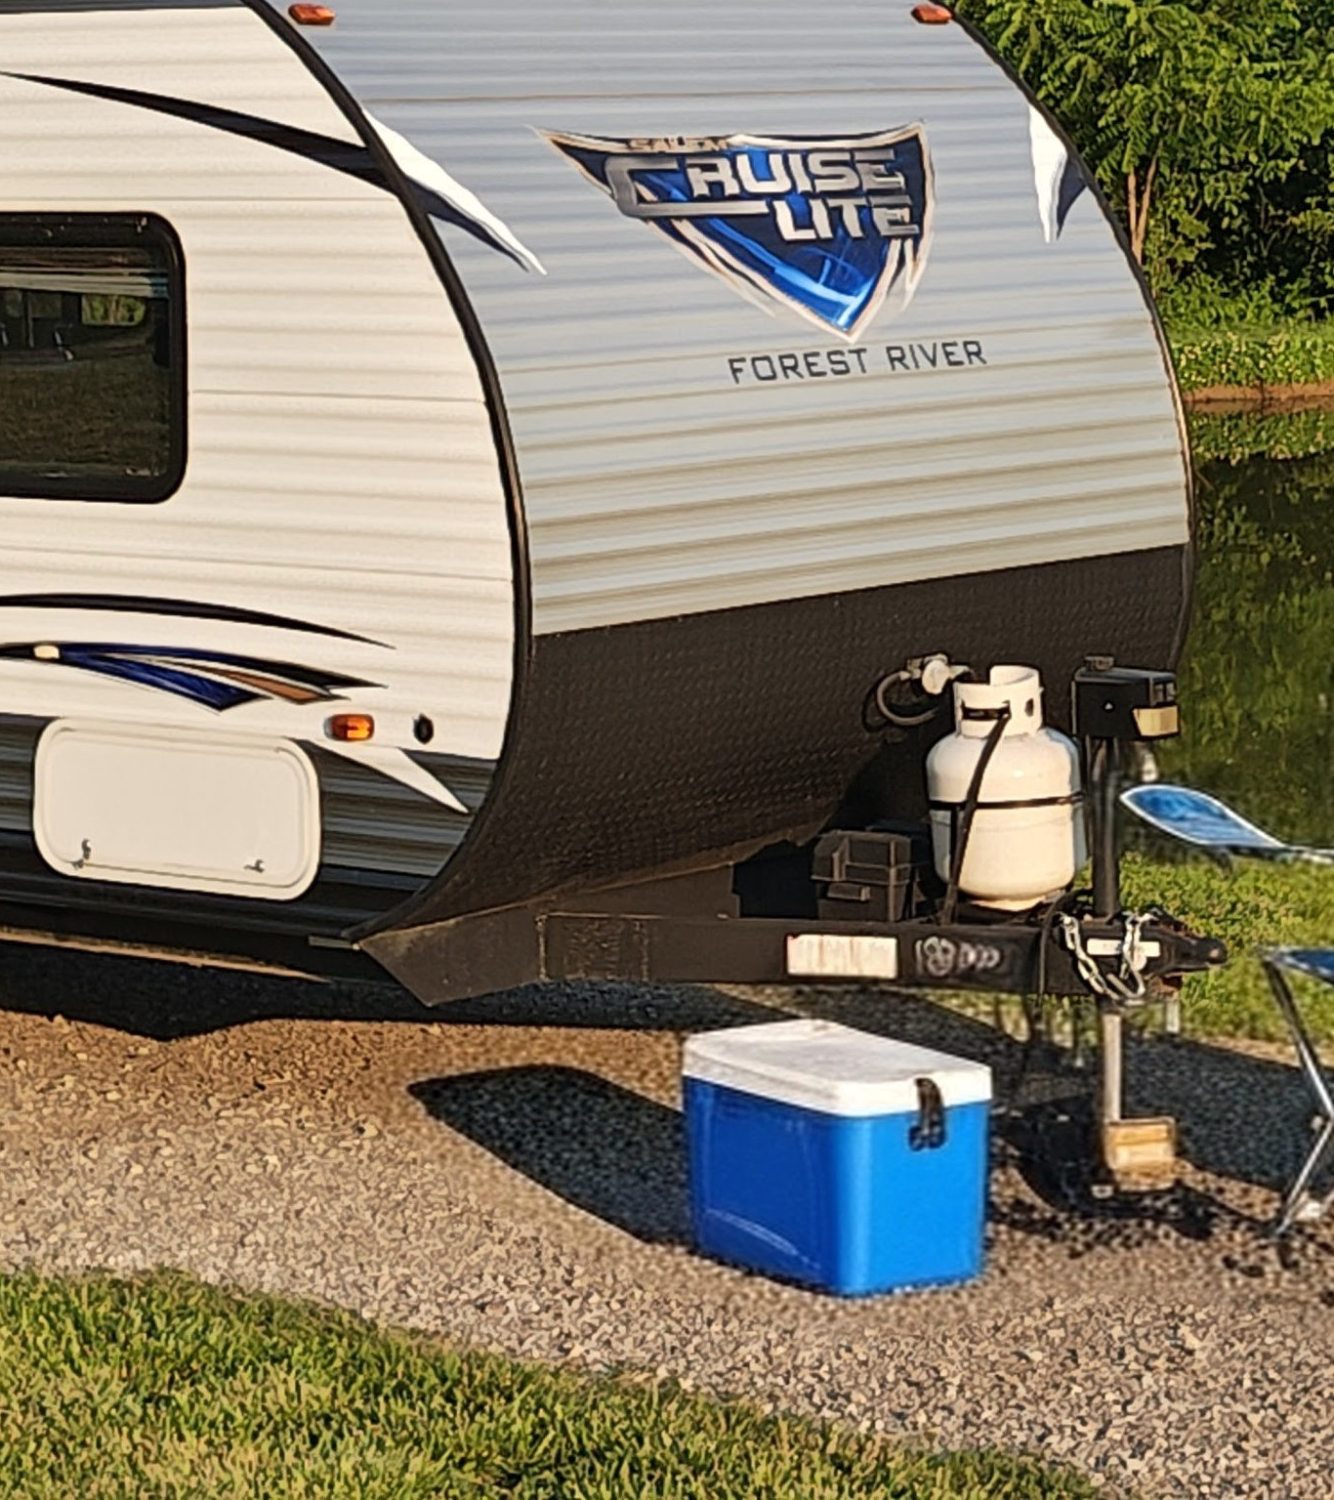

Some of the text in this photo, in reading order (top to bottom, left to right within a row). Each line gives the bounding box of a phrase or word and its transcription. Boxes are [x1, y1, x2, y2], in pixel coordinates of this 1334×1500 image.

[605, 149, 906, 219] CRUISE
[770, 194, 920, 242] LITE
[728, 340, 988, 384] FOREST RIVER
